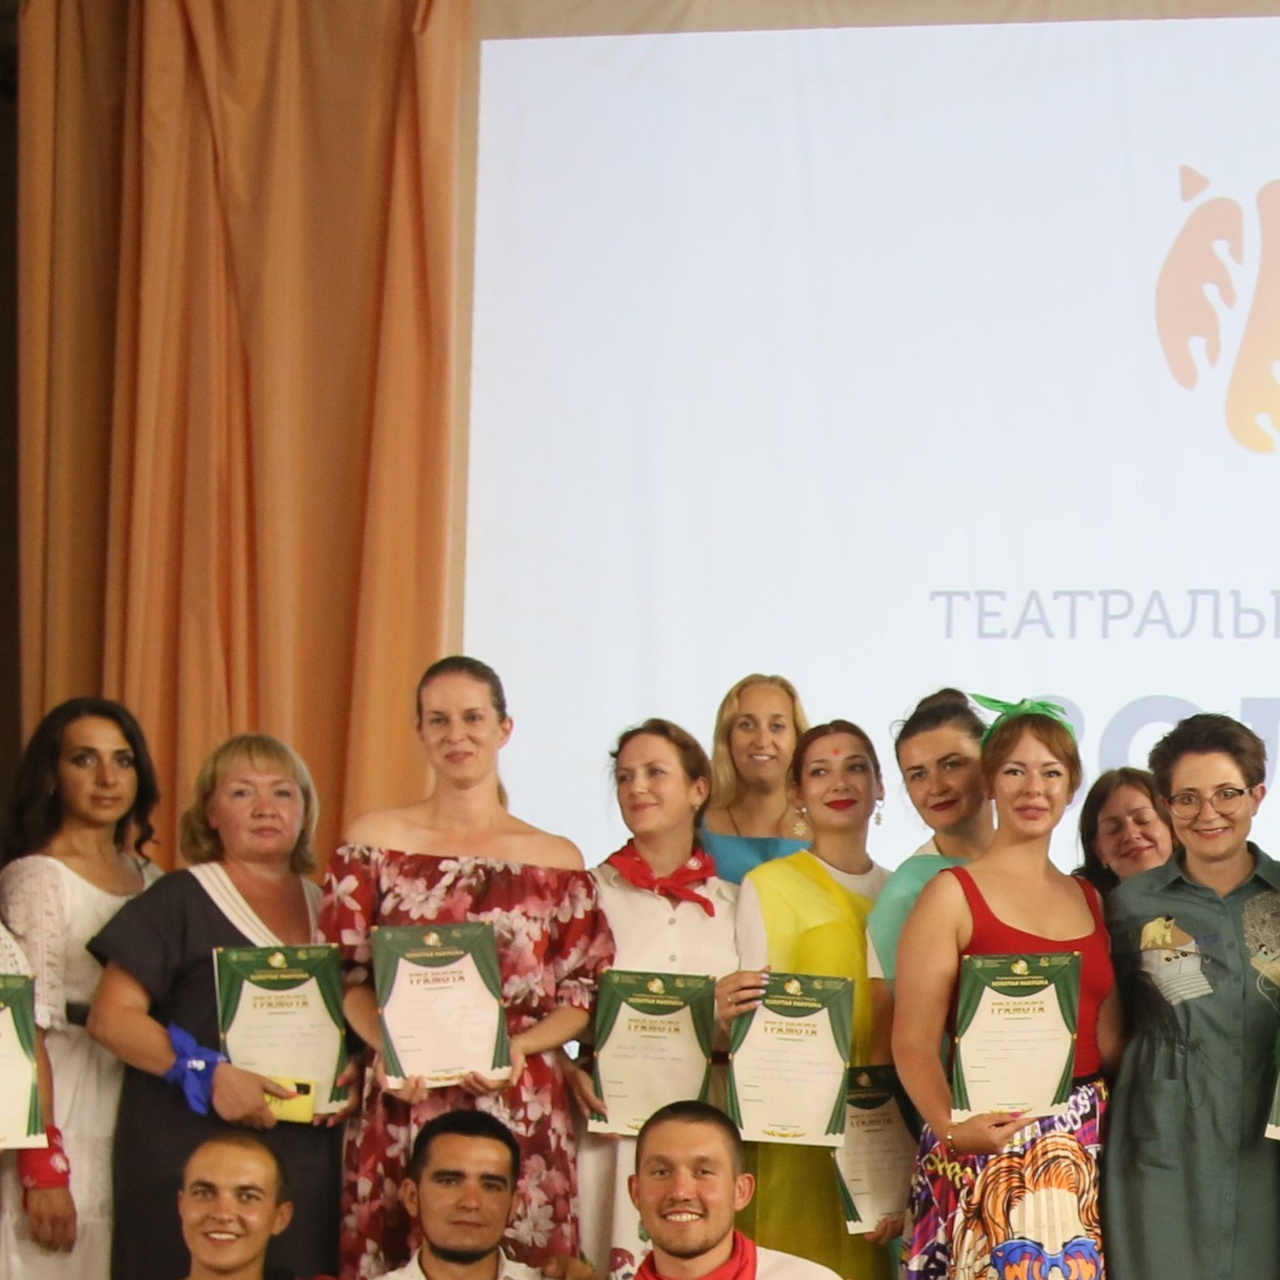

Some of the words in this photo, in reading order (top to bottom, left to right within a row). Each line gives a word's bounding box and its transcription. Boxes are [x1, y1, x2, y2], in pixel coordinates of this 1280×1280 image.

[409, 969, 466, 986] ГРАМОТА
[990, 1001, 1045, 1015] ГРАМОТА
[763, 1020, 818, 1036] ГРАМОТА
